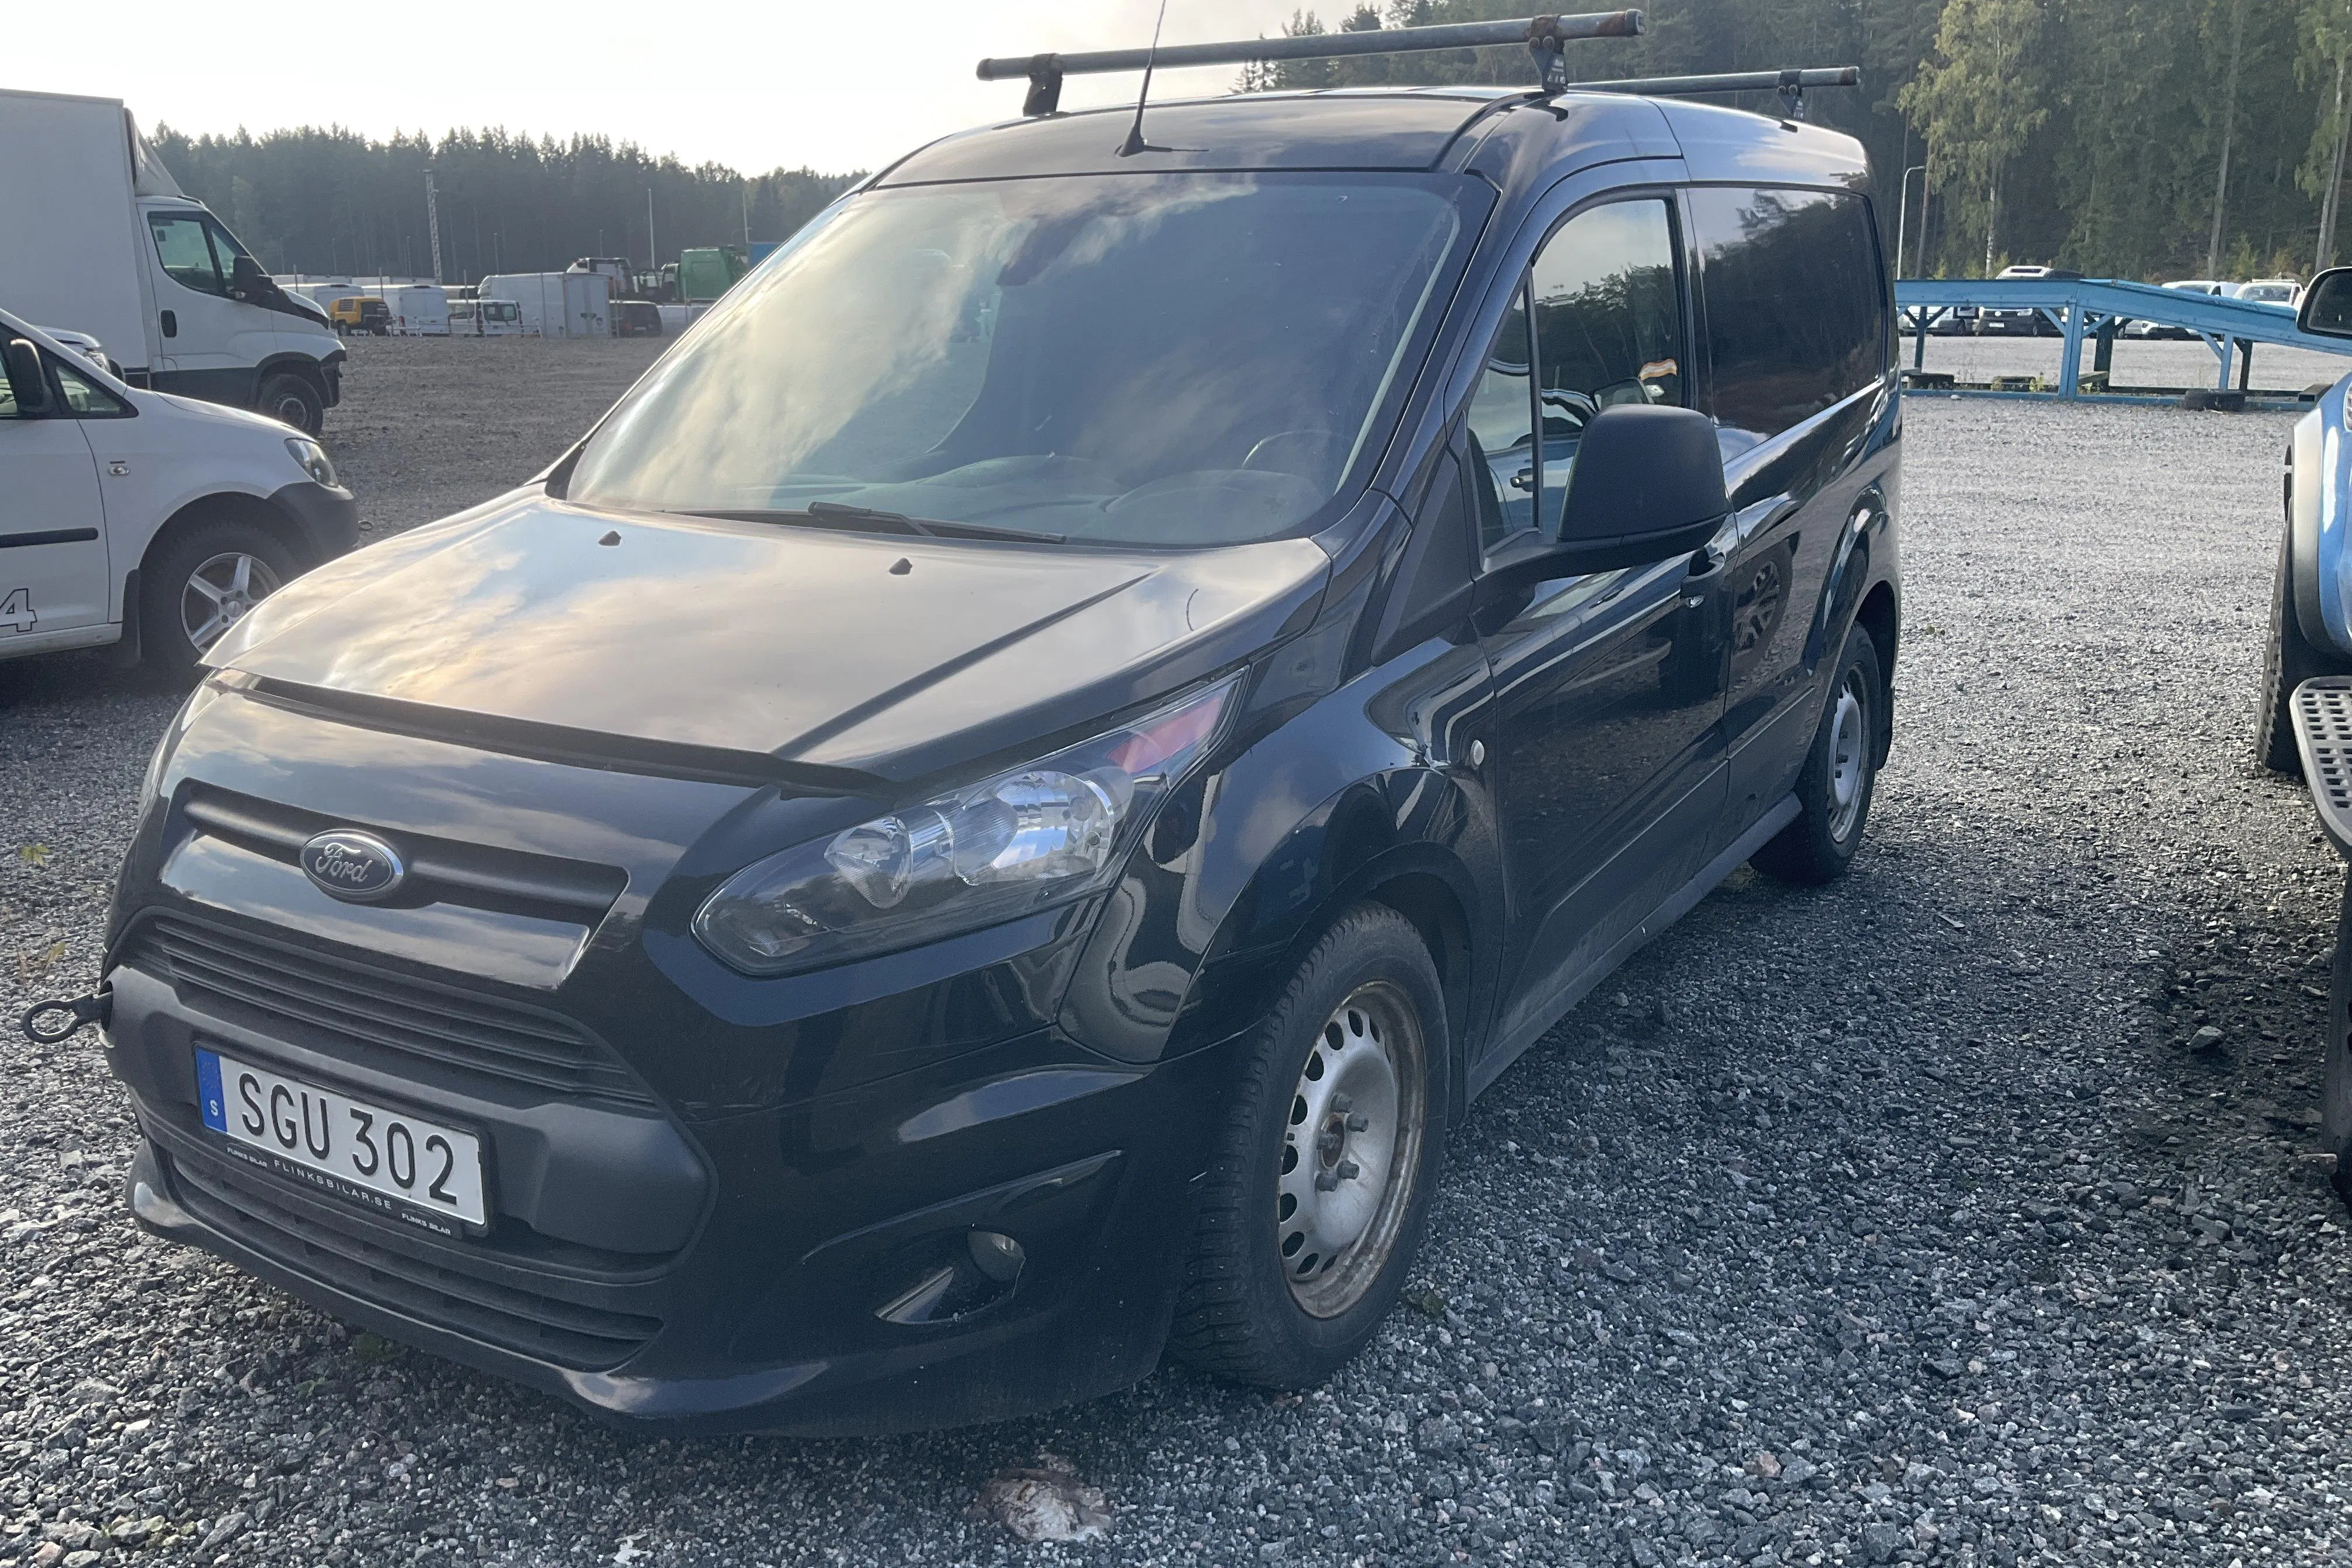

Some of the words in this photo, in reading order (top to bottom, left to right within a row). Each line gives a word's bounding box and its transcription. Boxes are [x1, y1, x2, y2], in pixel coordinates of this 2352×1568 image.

[0, 588, 37, 633] 4
[315, 842, 373, 883] Ford
[210, 1099, 219, 1116] S
[239, 1072, 331, 1160] SGU
[350, 1107, 457, 1206] 302
[274, 1159, 393, 1210] FLINKSBILAR.SE
